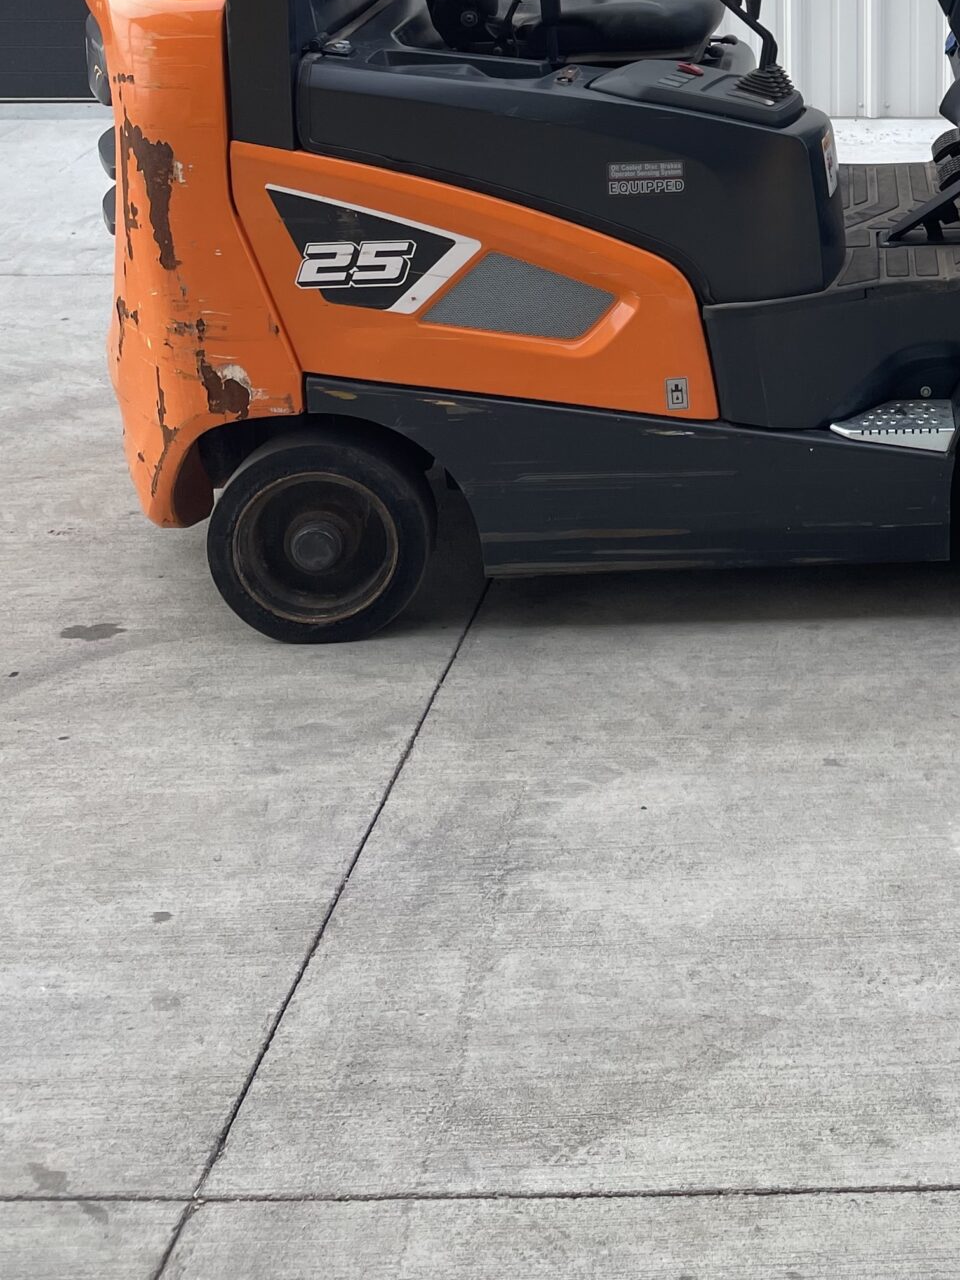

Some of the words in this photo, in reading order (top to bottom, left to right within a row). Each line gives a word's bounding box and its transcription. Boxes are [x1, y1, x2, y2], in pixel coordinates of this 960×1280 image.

[621, 163, 642, 171] Cooled
[609, 179, 684, 195] EQUIPPED
[295, 240, 417, 289] 25
